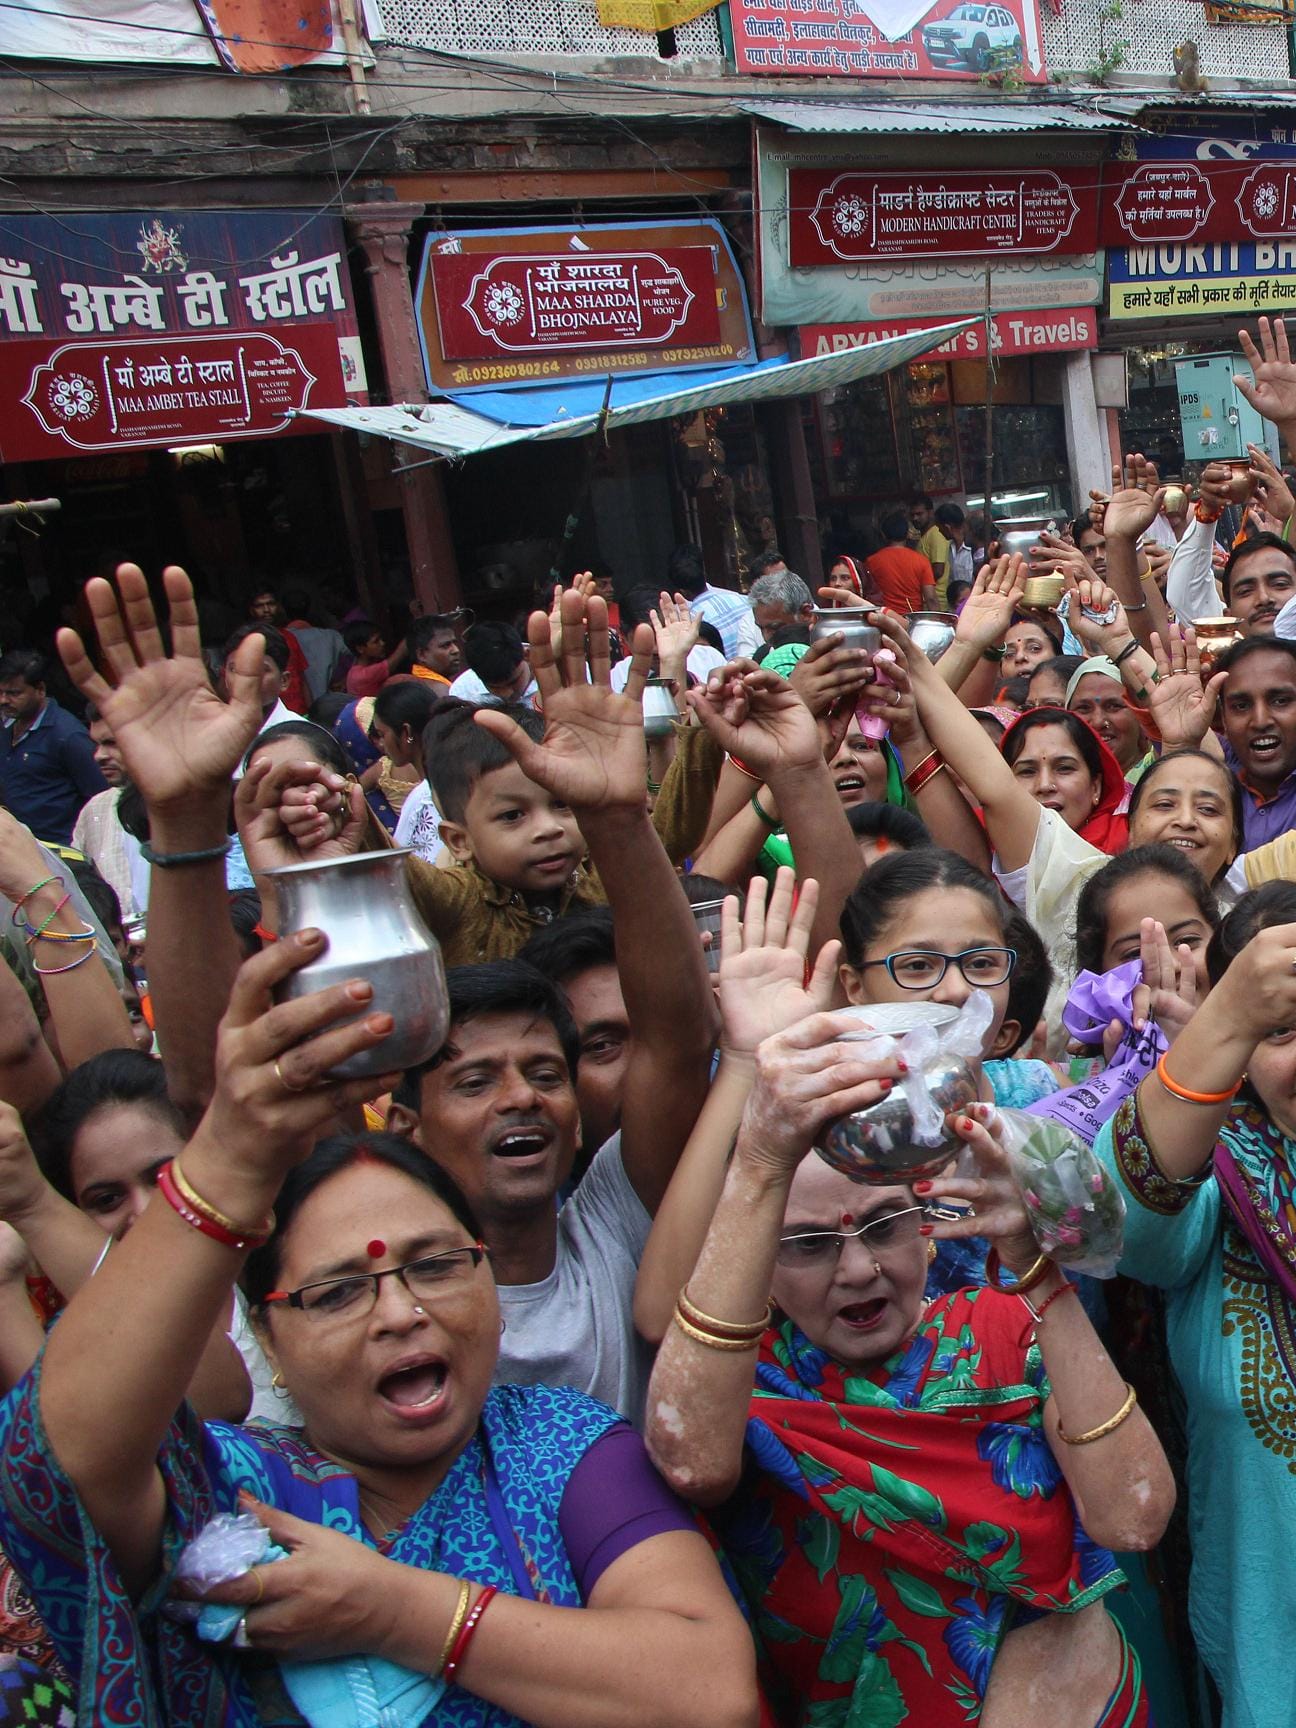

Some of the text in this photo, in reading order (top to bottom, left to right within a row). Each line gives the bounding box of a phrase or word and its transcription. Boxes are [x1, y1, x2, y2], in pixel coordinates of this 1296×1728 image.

[792, 21, 837, 42] इलाहाबाद
[745, 48, 766, 65] गया
[768, 45, 785, 66] एवं
[787, 49, 808, 66] अन्य
[810, 46, 832, 67] कार्य
[833, 48, 850, 72] हेतु
[850, 48, 872, 72] गाड़ी
[984, 184, 1016, 208] सेन्टर
[1137, 186, 1156, 202] हमारे
[1174, 186, 1197, 200] मार्बल
[880, 214, 1016, 233] MODERN HANDICRAFT CENTRE
[1025, 218, 1066, 226] HANDICRAFT
[1026, 210, 1055, 218] TRADERS
[1125, 208, 1137, 221] की
[1165, 209, 1194, 219] उपलब्ध
[1128, 242, 1239, 276] MURTI
[536, 260, 623, 280] माँ शारदा
[61, 273, 166, 333] अम्बे
[177, 271, 230, 326] टी
[239, 251, 346, 321] स्टॉल
[534, 277, 630, 293] भोजनालय
[1123, 286, 1151, 309] हमारे
[1154, 286, 1176, 307] यहाँ
[1177, 284, 1200, 304] सभी
[1202, 287, 1230, 306] प्रकार
[1232, 281, 1247, 301] की
[1250, 280, 1270, 308] मूर्ति
[1272, 280, 1296, 299] तैयार
[537, 292, 636, 310] MAA SHARDA
[642, 298, 682, 307] PURE VEG.
[652, 306, 675, 315] FOOD
[539, 310, 638, 330] BHOJNALAYA
[1009, 317, 1089, 346] Travels
[114, 357, 135, 389] माँ
[138, 356, 173, 387] अम्बे
[174, 354, 194, 385] टी
[195, 360, 236, 385] स्टाल
[118, 388, 242, 414] MAA AMBEY TEA STALL
[1180, 394, 1198, 404] IPDS
